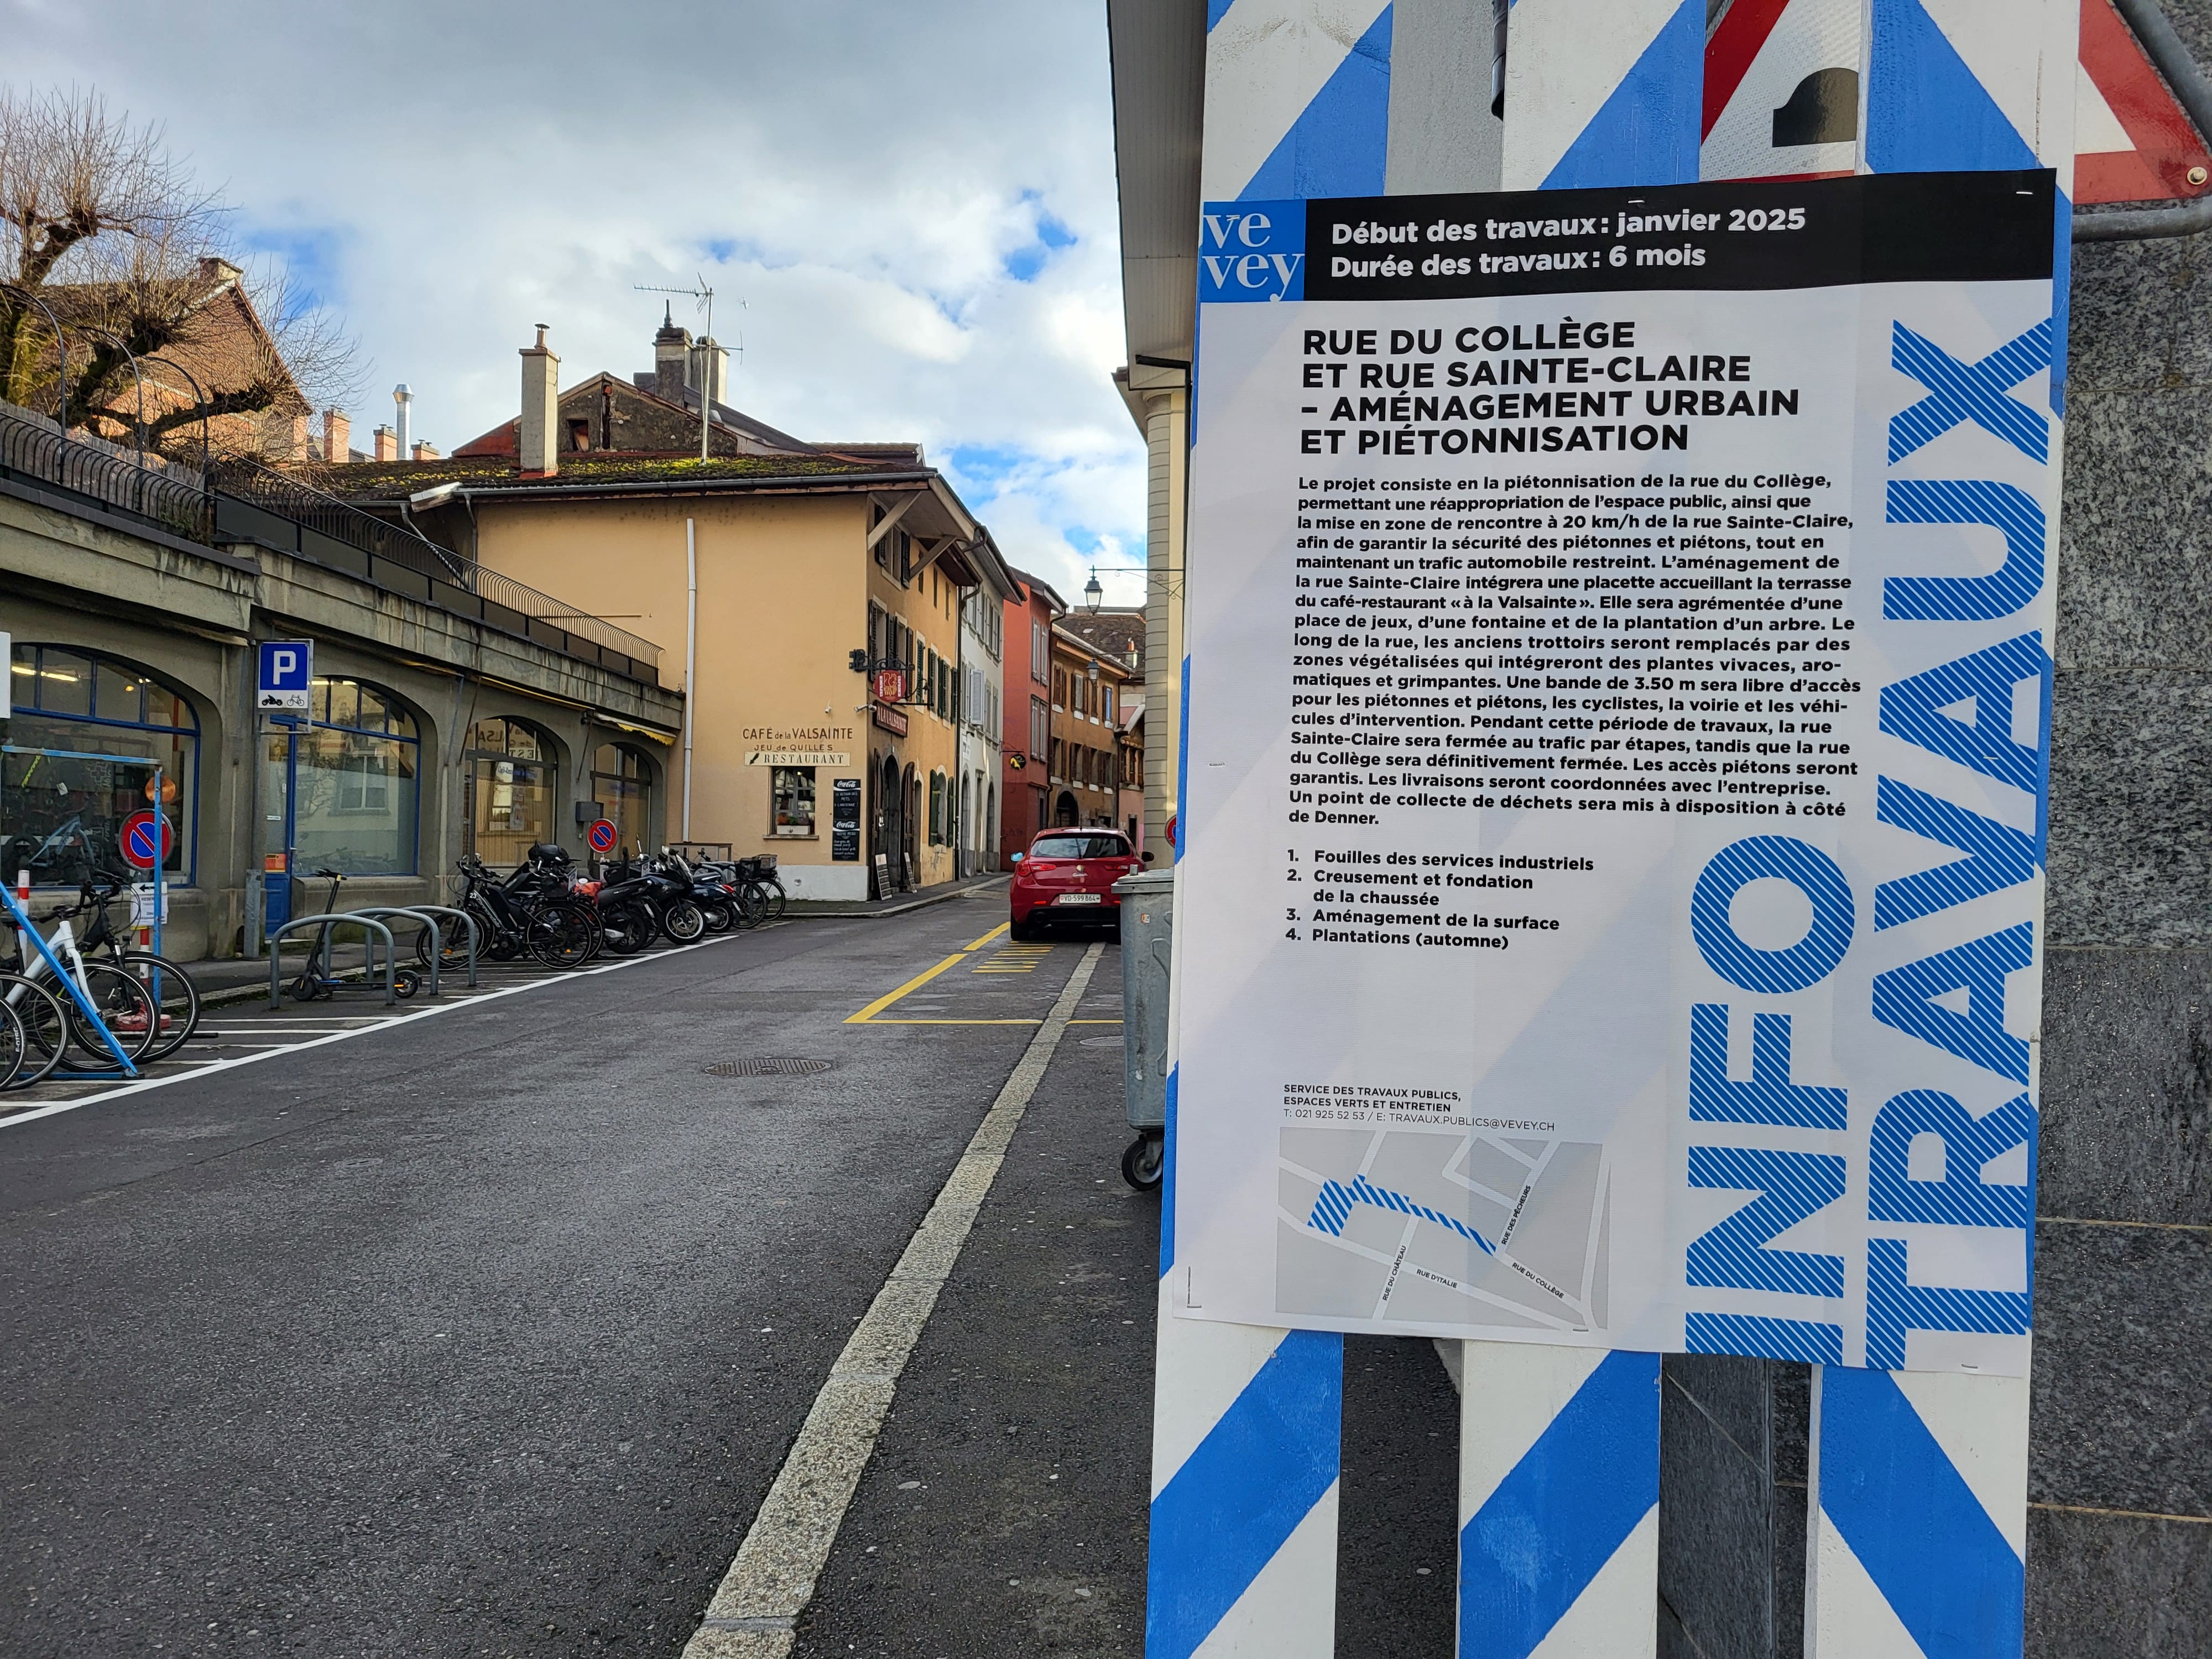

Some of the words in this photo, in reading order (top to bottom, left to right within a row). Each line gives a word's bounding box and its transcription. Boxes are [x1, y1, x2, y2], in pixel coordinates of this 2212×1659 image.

[1203, 213, 1271, 248] ve
[1333, 221, 1418, 244] Début
[1427, 220, 1477, 242] des
[1616, 209, 1720, 237] janvier
[1728, 208, 1805, 231] 2025
[1332, 254, 1413, 277] Durée
[1422, 254, 1471, 275] des
[1609, 246, 1627, 267] 6
[1636, 243, 1705, 265] mois
[1202, 254, 1305, 301] vey
[1304, 330, 1377, 355] RUE
[1390, 329, 1442, 354] DU
[1455, 316, 1635, 353] COLLÈGE
[1303, 363, 1348, 388] ET
[1360, 363, 1434, 388] RUE
[1446, 356, 1750, 387] SAINTE-CLAIRE
[1329, 390, 1632, 421] AMÉNAGEMENT
[1646, 389, 1798, 416] URBAIN
[1301, 430, 1345, 454] ET
[1359, 424, 1687, 455] PIÉTONNISATION
[1299, 477, 1318, 489] Le
[1323, 477, 1375, 493] projet
[1380, 478, 1452, 491] consiste
[1457, 479, 1478, 490] en
[1484, 476, 1499, 489] la
[1505, 474, 1635, 492] piétonnisation
[1641, 474, 1663, 487] de
[1670, 474, 1684, 487] la
[1691, 477, 1719, 488] rue
[1725, 474, 1747, 488] du
[1754, 473, 1831, 489] Collège,
[1298, 498, 1391, 511] permettant
[1395, 500, 1426, 510] une
[1430, 495, 1563, 513] réappropriation
[1568, 495, 1590, 508] de
[1595, 495, 1665, 510] l’espace
[1670, 494, 1726, 511] public,
[1731, 495, 1771, 509] ainsi
[1776, 497, 1811, 510] que
[1297, 535, 1328, 549] afin
[1333, 536, 1354, 549] de
[1359, 537, 1427, 552] garantir
[1432, 537, 1447, 550] la
[1452, 535, 1521, 549] sécurité
[1527, 535, 1557, 549] des
[1563, 534, 1651, 551] piétonnes
[1657, 535, 1675, 548] et
[1680, 535, 1750, 552] piétons,
[1756, 536, 1796, 549] tout
[1801, 538, 1823, 549] en
[1296, 555, 1389, 569] maintenant
[1394, 560, 1414, 570] un
[1418, 556, 1463, 570] trafic
[1467, 555, 1567, 569] automobile
[1573, 555, 1656, 568] restreint.
[1662, 555, 1809, 572] L’aménagement
[1815, 555, 1839, 568] de
[1296, 575, 1310, 587] la
[1316, 578, 1343, 588] rue
[1348, 576, 1460, 589] Sainte-Claire
[1466, 575, 1543, 591] intégrera
[1548, 578, 1579, 588] une
[1584, 575, 1655, 591] placette
[1660, 576, 1752, 590] accueillant
[1757, 576, 1772, 590] la
[1777, 577, 1851, 590] terrasse
[273, 651, 296, 685] P
[743, 726, 773, 739] CAFÉ
[785, 731, 791, 739] la
[764, 754, 844, 764] RESTAURANT
[1290, 771, 1363, 785] garantis.
[1369, 773, 1397, 785] Les
[1402, 773, 1484, 787] livraisons
[1489, 776, 1545, 789] seront
[1551, 776, 1666, 791] coordonnées
[1672, 781, 1712, 792] avec
[1718, 780, 1830, 797] l’entreprise.
[1288, 810, 1310, 822] de
[1315, 811, 1379, 825] Denner.
[1866, 317, 2052, 1369] TRAVAUX
[1287, 849, 1299, 862] 1.
[1315, 849, 1381, 864] Fouilles
[1386, 852, 1416, 865] des
[1422, 853, 1494, 867] services
[1500, 854, 1593, 870] industriels
[1287, 869, 1302, 881] 2.
[1314, 869, 1418, 884] Creusement
[1423, 873, 1441, 886] et
[1446, 873, 1532, 889] fondation
[1313, 890, 1334, 903] de
[1340, 890, 1354, 904] la
[1360, 891, 1439, 906] chaussée
[1286, 908, 1301, 921] 3.
[1312, 909, 1441, 926] Aménagement
[1446, 913, 1468, 926] de
[1474, 914, 1488, 927] la
[1494, 916, 1559, 930] surface
[1285, 928, 1301, 941] 4.
[1313, 929, 1410, 945] Plantations
[1416, 932, 1508, 950] (automne)
[1284, 1084, 1329, 1094] SERVICE
[1333, 1086, 1354, 1094] DES
[1358, 1087, 1408, 1097] TRAVAUX
[1412, 1090, 1460, 1102] PUBLICS,
[1686, 835, 1855, 1366] INFO
[1284, 1097, 1331, 1106] ESPACES
[1335, 1099, 1369, 1108] VERTS
[1390, 1101, 1451, 1112] ENTRETIEN
[1284, 1109, 1292, 1118] T:
[1295, 1109, 1312, 1118] 021
[1316, 1110, 1334, 1119] 925
[1337, 1111, 1349, 1119] 52
[1353, 1112, 1365, 1120] 53
[1367, 1112, 1374, 1121] /
[1376, 1113, 1386, 1121] E:
[1389, 1113, 1554, 1131] TRAVAUX.PUBLICS@VEVEY.CH
[1501, 1231, 1510, 1245] RUE
[1507, 1218, 1516, 1231] DES
[1383, 1287, 1391, 1301] RUE
[1388, 1276, 1395, 1287] DU
[1392, 1245, 1406, 1275] CHÂTEAU
[1417, 1269, 1430, 1278] RUE
[1512, 1262, 1525, 1274] RUE
[1525, 1271, 1535, 1279] DU
[1536, 1278, 1564, 1298] COLLÈGE
